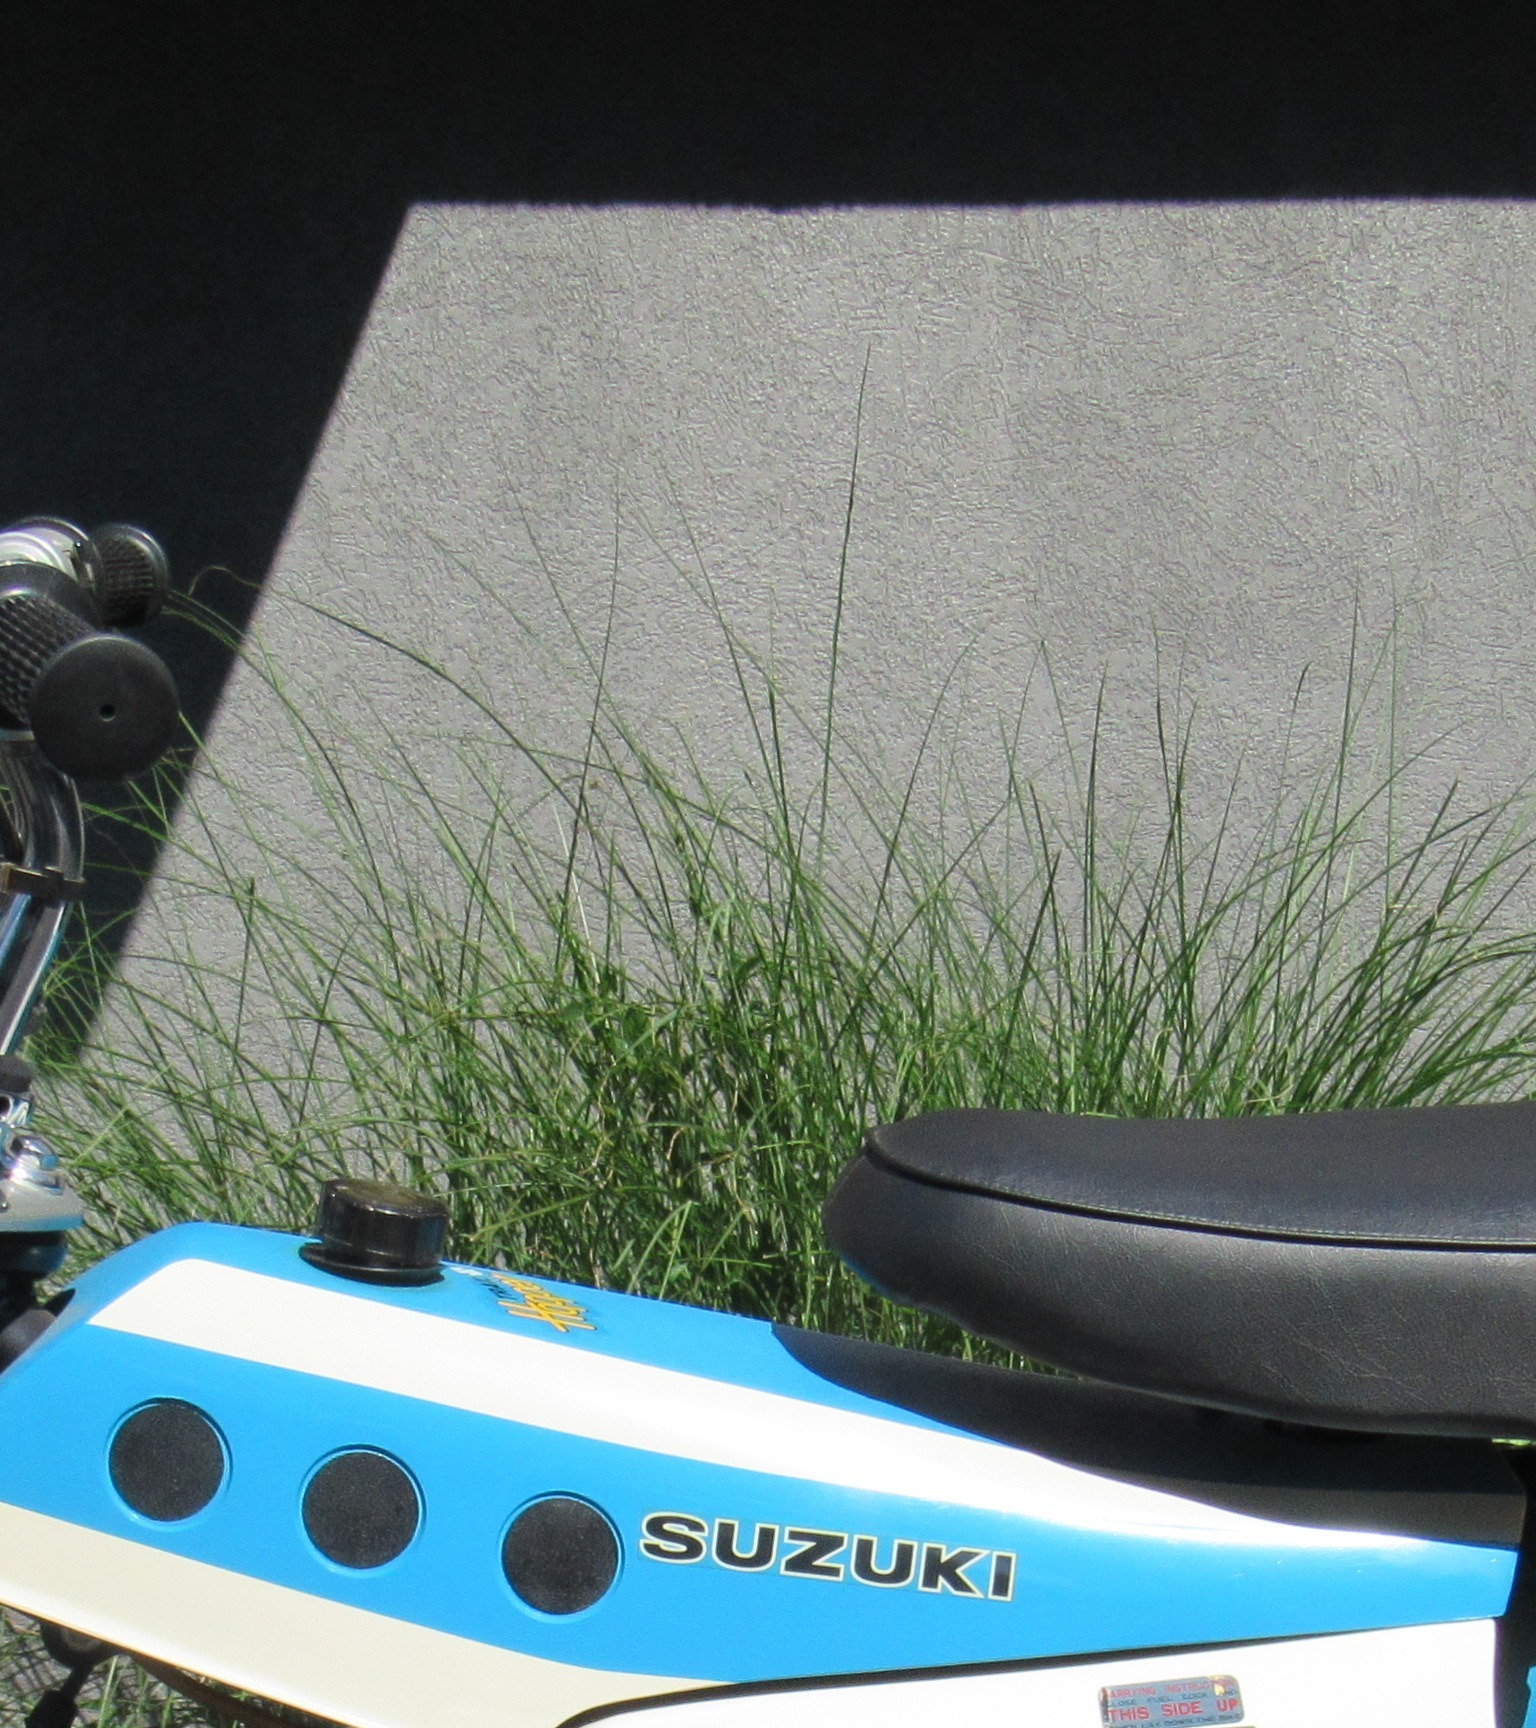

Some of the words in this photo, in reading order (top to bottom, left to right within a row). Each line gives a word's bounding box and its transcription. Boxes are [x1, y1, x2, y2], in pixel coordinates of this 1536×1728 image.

[639, 1511, 1017, 1602] SUZUKI
[1108, 1686, 1157, 1699] ARRYING
[1107, 1706, 1150, 1722] THIS
[1161, 1701, 1203, 1717] SIDE
[1216, 1697, 1239, 1712] UP
